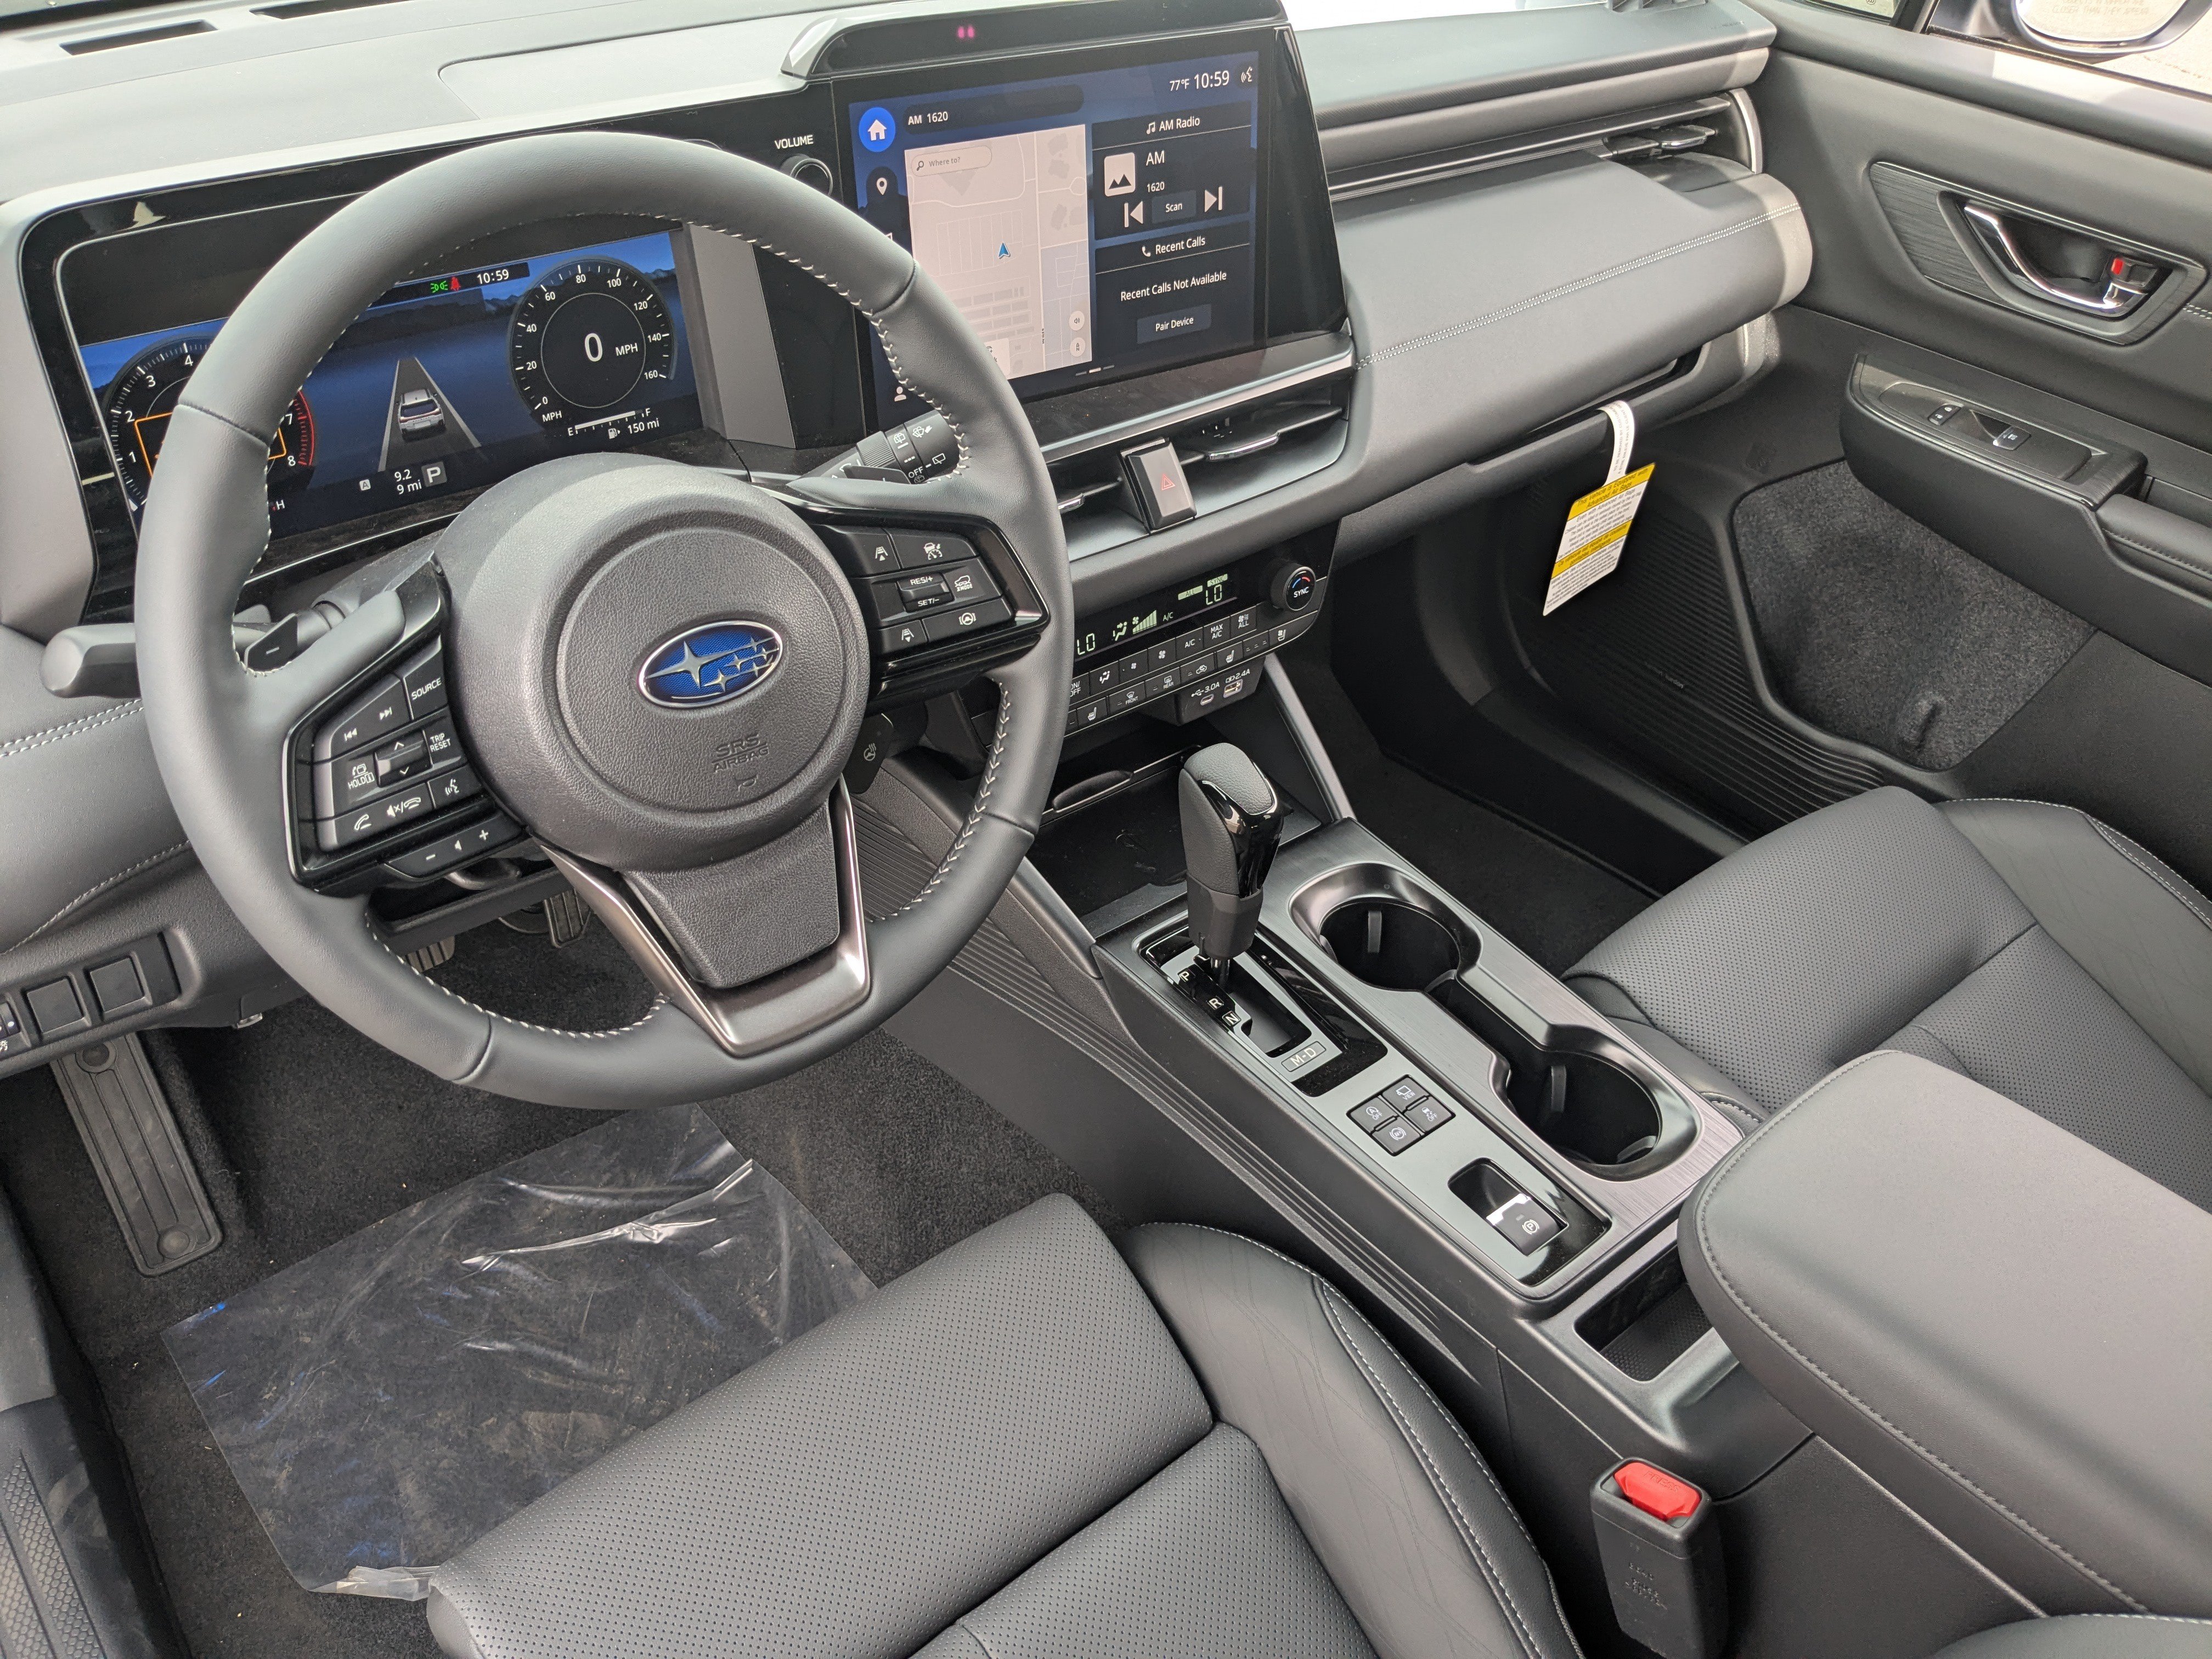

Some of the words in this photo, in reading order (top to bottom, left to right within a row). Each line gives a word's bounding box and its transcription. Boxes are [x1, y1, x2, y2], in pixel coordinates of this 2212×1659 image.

[1194, 70, 1229, 89] 10:59
[908, 115, 922, 125] AM
[927, 111, 949, 123] 1620
[1159, 120, 1173, 132] AM
[1176, 116, 1200, 129] Radio
[774, 134, 814, 149] VOLUME
[929, 159, 950, 167] Where
[1146, 150, 1165, 166] AM
[1147, 181, 1165, 193] 1620
[1165, 202, 1183, 213] Scan
[1155, 240, 1184, 255] Recent
[1186, 235, 1205, 248] Calls
[477, 269, 509, 284] 10:59
[576, 274, 586, 283] 80
[607, 278, 622, 288] 100
[1121, 287, 1150, 301] Recent
[1152, 283, 1171, 295] Calls
[1173, 280, 1189, 291] Not
[1190, 271, 1227, 287] Available
[545, 291, 556, 301] 60
[634, 301, 648, 311] 120
[526, 324, 537, 333] 40
[1155, 321, 1170, 331] Pair
[1171, 317, 1194, 329] Device
[647, 332, 662, 343] 140
[584, 333, 603, 362] 0
[615, 342, 639, 357] MPH
[184, 355, 194, 366] 4
[526, 361, 537, 370] 20
[644, 370, 658, 380] 160
[145, 375, 156, 387] 3
[542, 396, 548, 404] 0
[125, 410, 135, 423] 2
[542, 410, 562, 422] MPH
[645, 408, 651, 417] F
[285, 413, 292, 425] 7
[627, 421, 645, 434] 150
[647, 417, 659, 430] mi
[567, 427, 573, 436] E
[129, 451, 136, 464] 1
[287, 455, 296, 466] 8
[394, 469, 411, 482] 9.2
[427, 466, 441, 483] P
[909, 466, 924, 478] OFF
[397, 484, 404, 494] 9
[407, 479, 422, 492] mi
[276, 500, 285, 510] H
[1210, 575, 1224, 586] SYNC
[1294, 586, 1310, 598] SYNC
[1163, 612, 1173, 622] A/C
[1210, 624, 1223, 633] MAX
[1238, 620, 1249, 629] ALL
[1211, 631, 1222, 639] A/C
[1184, 639, 1195, 648] A/C
[1235, 669, 1250, 680] 2.4A
[411, 678, 442, 701] SOURCE
[1163, 681, 1174, 690] REAR
[1204, 681, 1220, 693] 3.0A
[1125, 696, 1138, 705] FRONT
[430, 733, 445, 743] TRIP
[430, 738, 451, 752] RESET
[715, 733, 761, 757] SRS
[713, 747, 770, 773] AIRBAG
[348, 777, 366, 789] HOLD
[1179, 971, 1189, 981] P
[1209, 998, 1222, 1008] R
[1225, 1013, 1239, 1024] N
[1402, 1091, 1416, 1101] VIEW
[1372, 1112, 1383, 1120] OFF
[1427, 1113, 1437, 1121] OFF
[1643, 1471, 1680, 1492] PRESS
